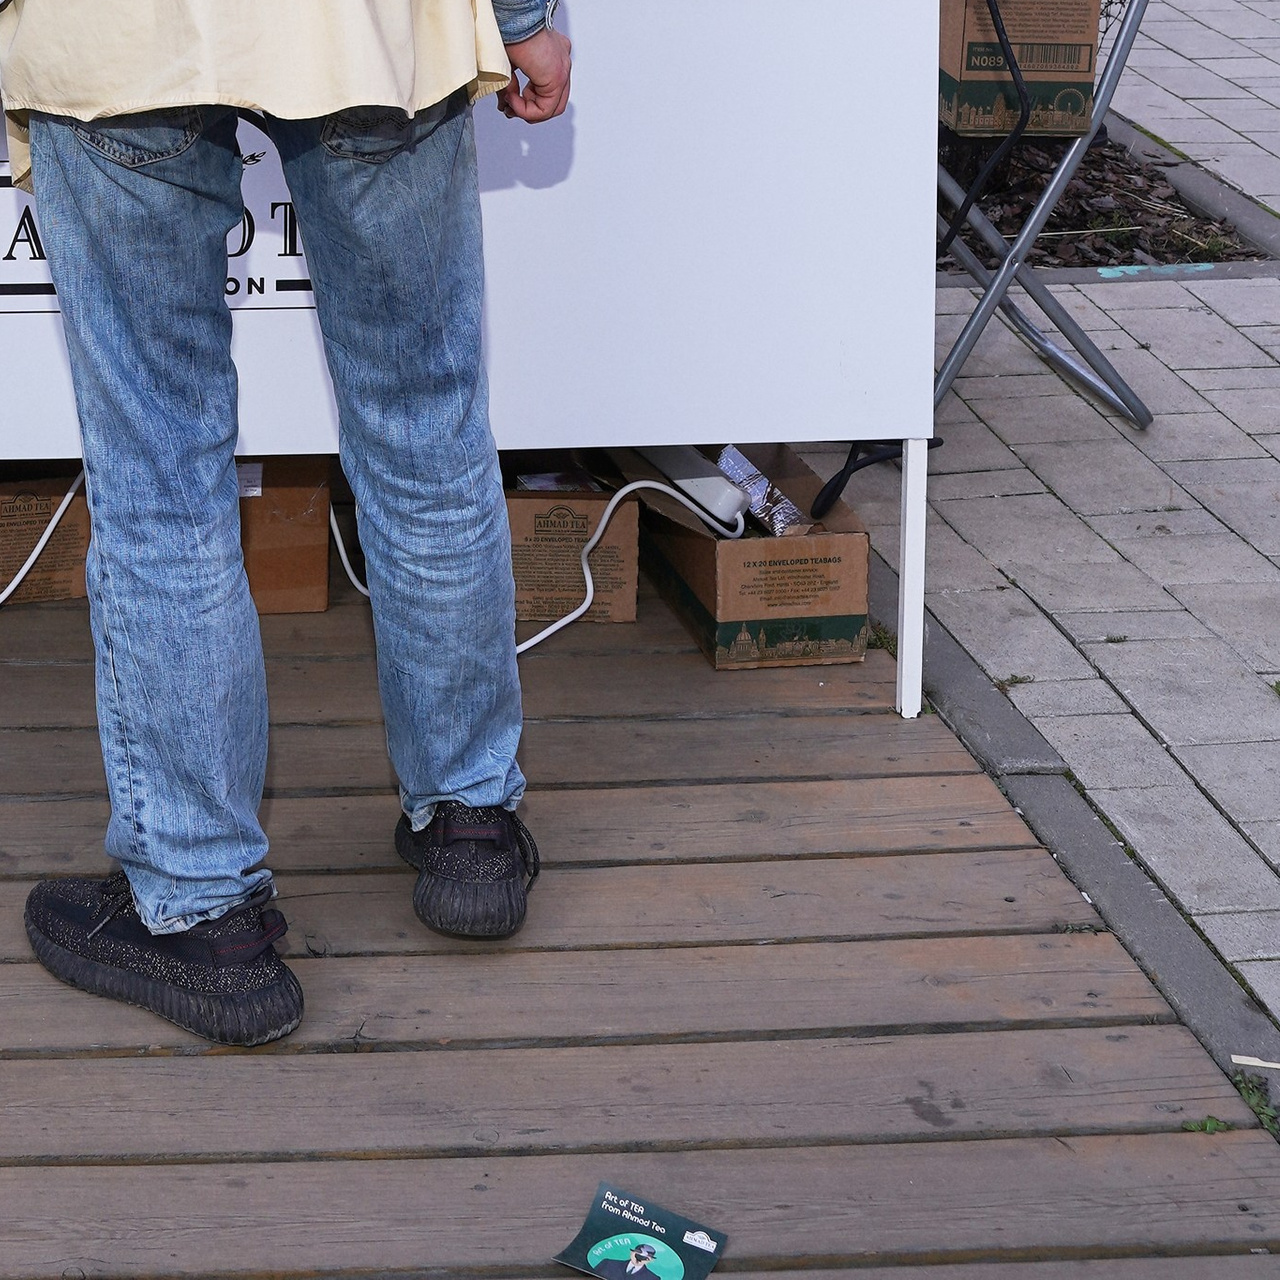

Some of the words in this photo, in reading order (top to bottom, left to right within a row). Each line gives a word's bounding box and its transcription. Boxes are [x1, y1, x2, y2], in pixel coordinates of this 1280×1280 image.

[971, 55, 1004, 67] N089
[2, 503, 33, 514] AHMAD
[34, 502, 49, 511] TEA
[6, 520, 37, 528] ENVELOPED
[536, 520, 569, 529] AHMAD
[570, 520, 587, 529] TEA
[768, 558, 809, 567] ENVELOPED
[810, 556, 842, 564] TEABAGS
[605, 1191, 618, 1204] Art
[619, 1198, 630, 1209] of
[630, 1201, 645, 1215] TEA
[601, 1200, 621, 1216] from
[621, 1209, 650, 1227] Ahmad
[604, 1241, 613, 1250] of
[615, 1237, 632, 1247] TEA
